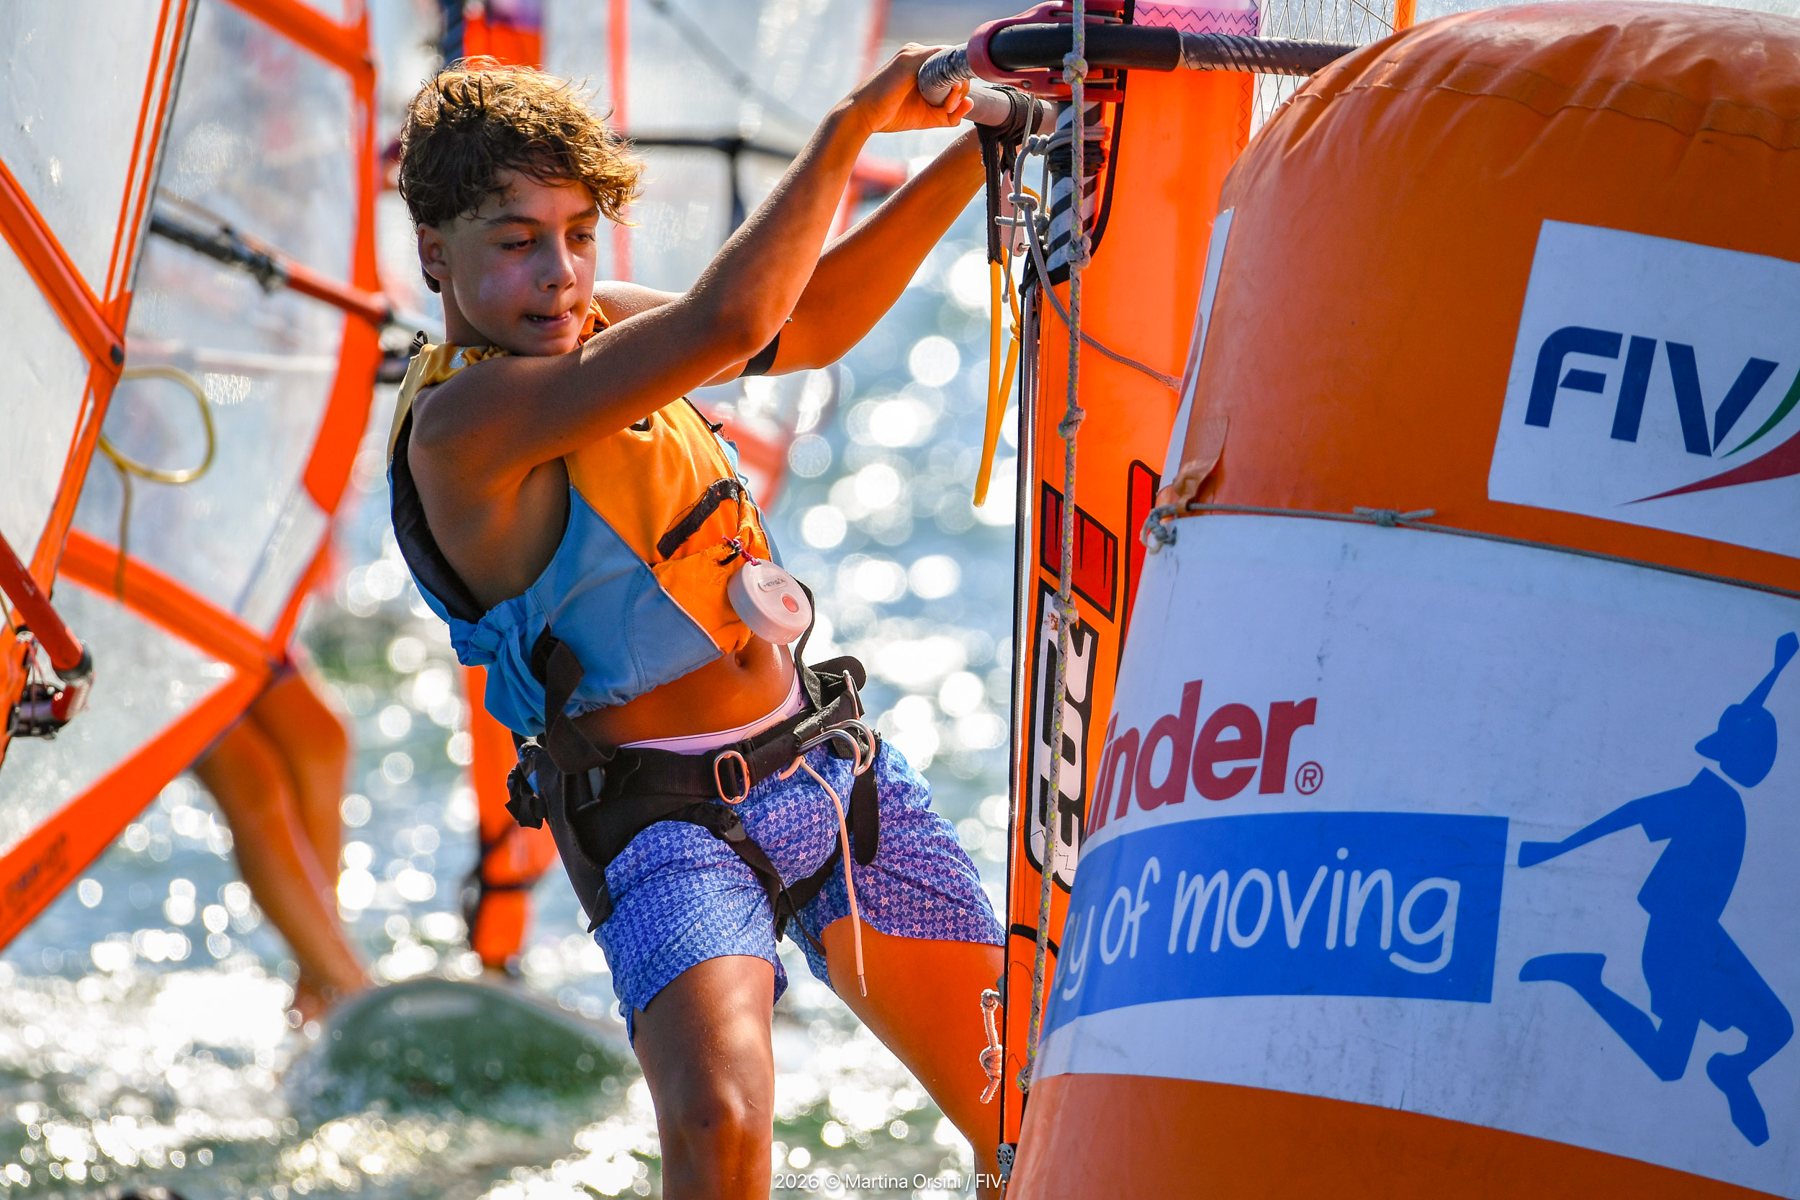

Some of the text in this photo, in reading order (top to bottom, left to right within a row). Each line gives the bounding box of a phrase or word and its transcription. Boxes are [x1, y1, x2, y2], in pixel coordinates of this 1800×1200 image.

[1525, 326, 1779, 457] FIV
[1100, 856, 1160, 965] of
[1168, 847, 1461, 974] moving
